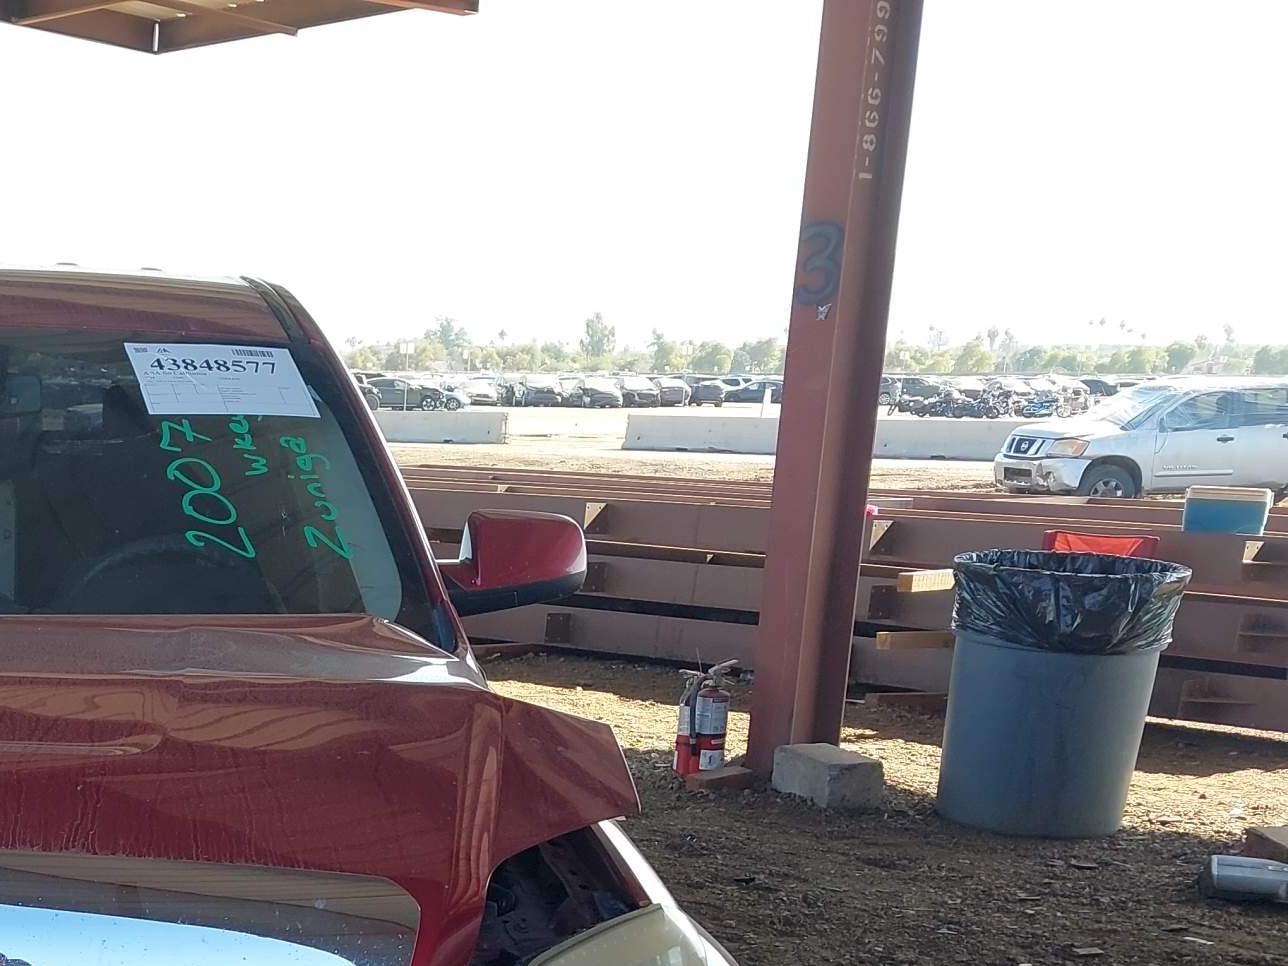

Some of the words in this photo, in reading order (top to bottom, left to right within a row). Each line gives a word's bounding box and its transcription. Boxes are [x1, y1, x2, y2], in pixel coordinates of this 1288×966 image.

[793, 220, 844, 305] 3
[150, 357, 276, 375] 43848577
[160, 418, 257, 560] 2007
[280, 435, 352, 560] Zuniga
